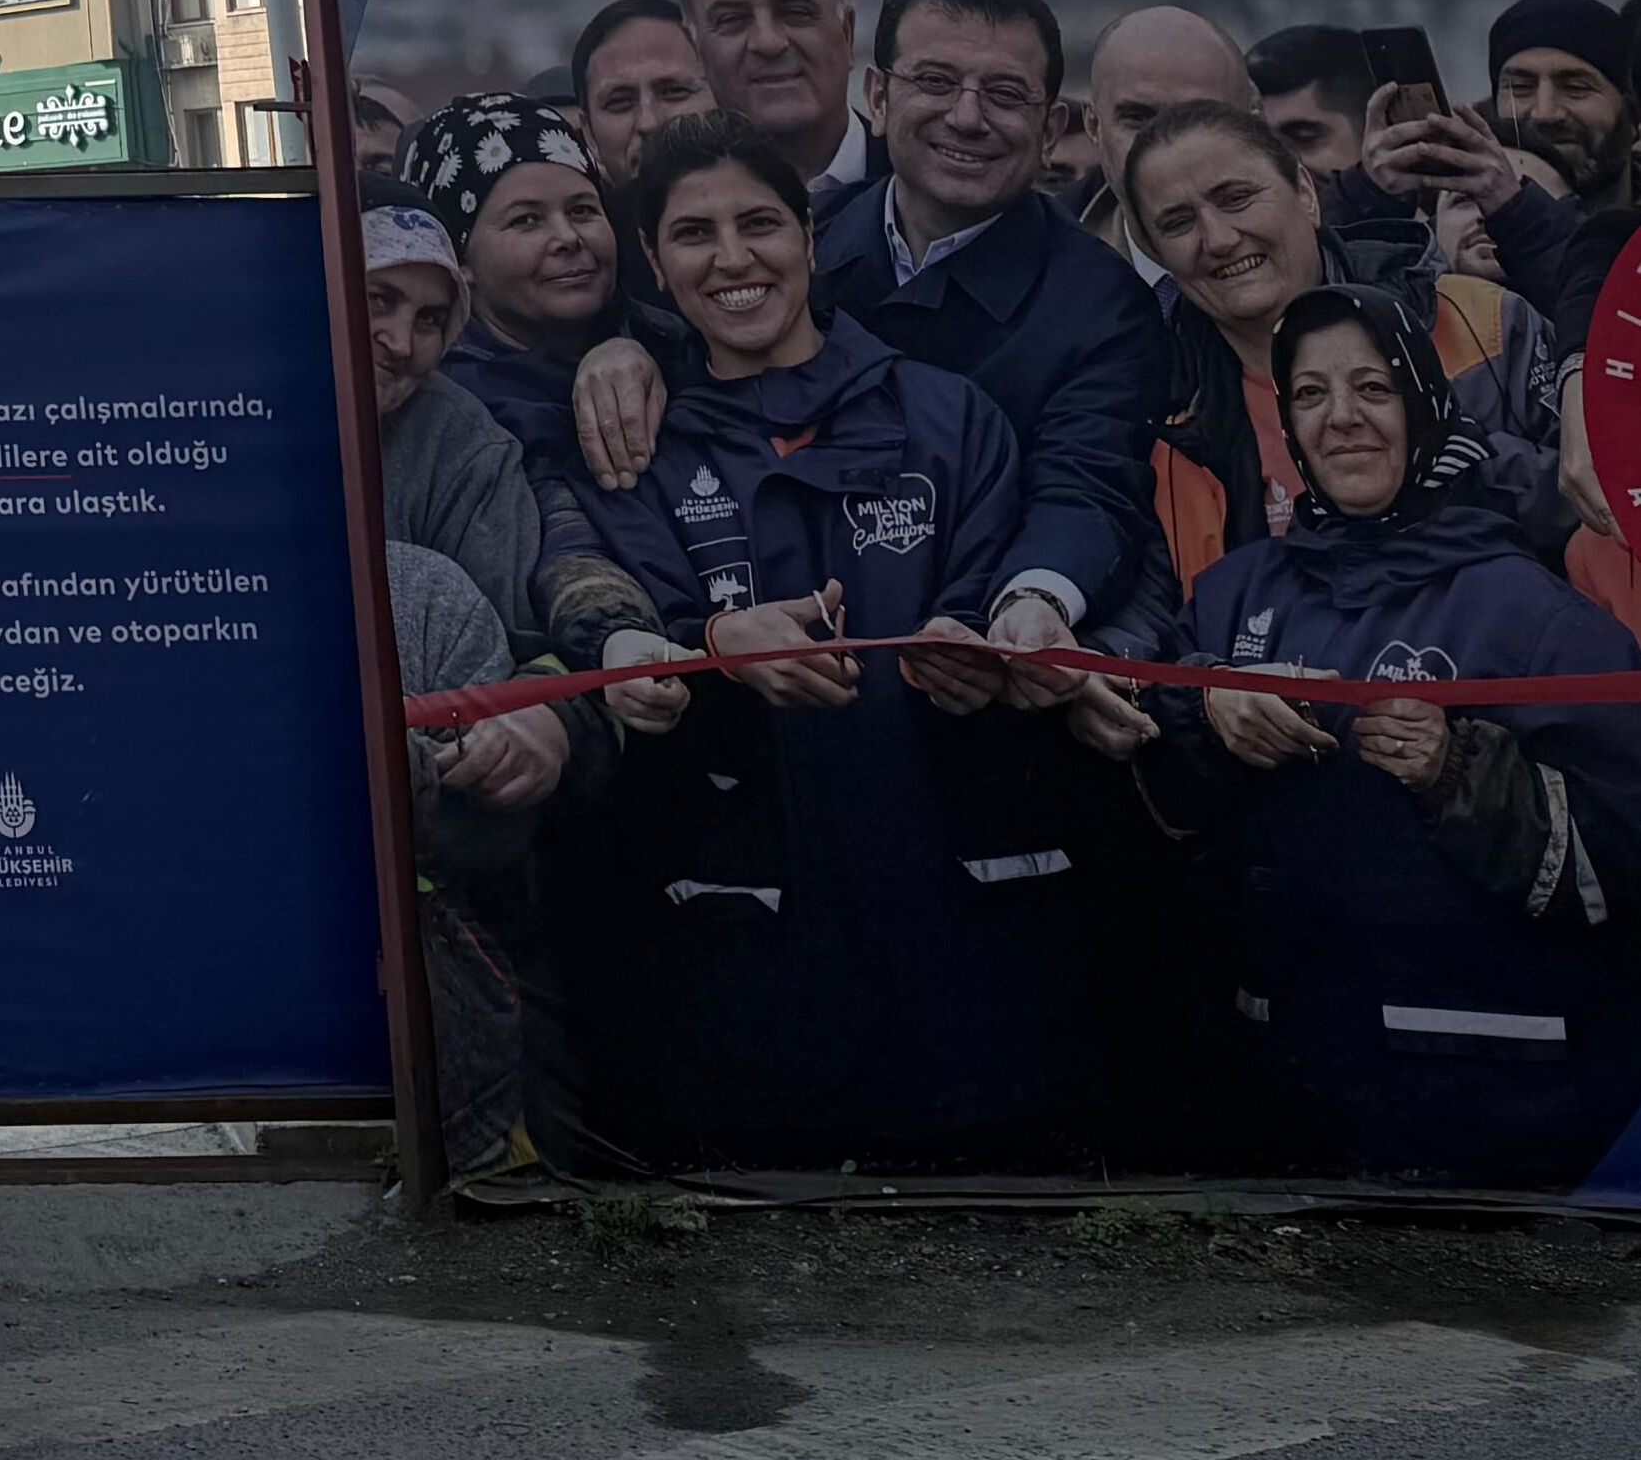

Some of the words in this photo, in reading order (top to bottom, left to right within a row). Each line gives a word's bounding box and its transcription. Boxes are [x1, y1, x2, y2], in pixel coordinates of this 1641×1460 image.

[44, 393, 274, 425] çalışmalarında,
[76, 442, 119, 468] ait
[127, 440, 228, 471] olduğu
[55, 488, 166, 518] ulaştık.
[124, 568, 269, 601] yürütülen
[68, 624, 102, 644] ve
[111, 616, 258, 648] otoparkın
